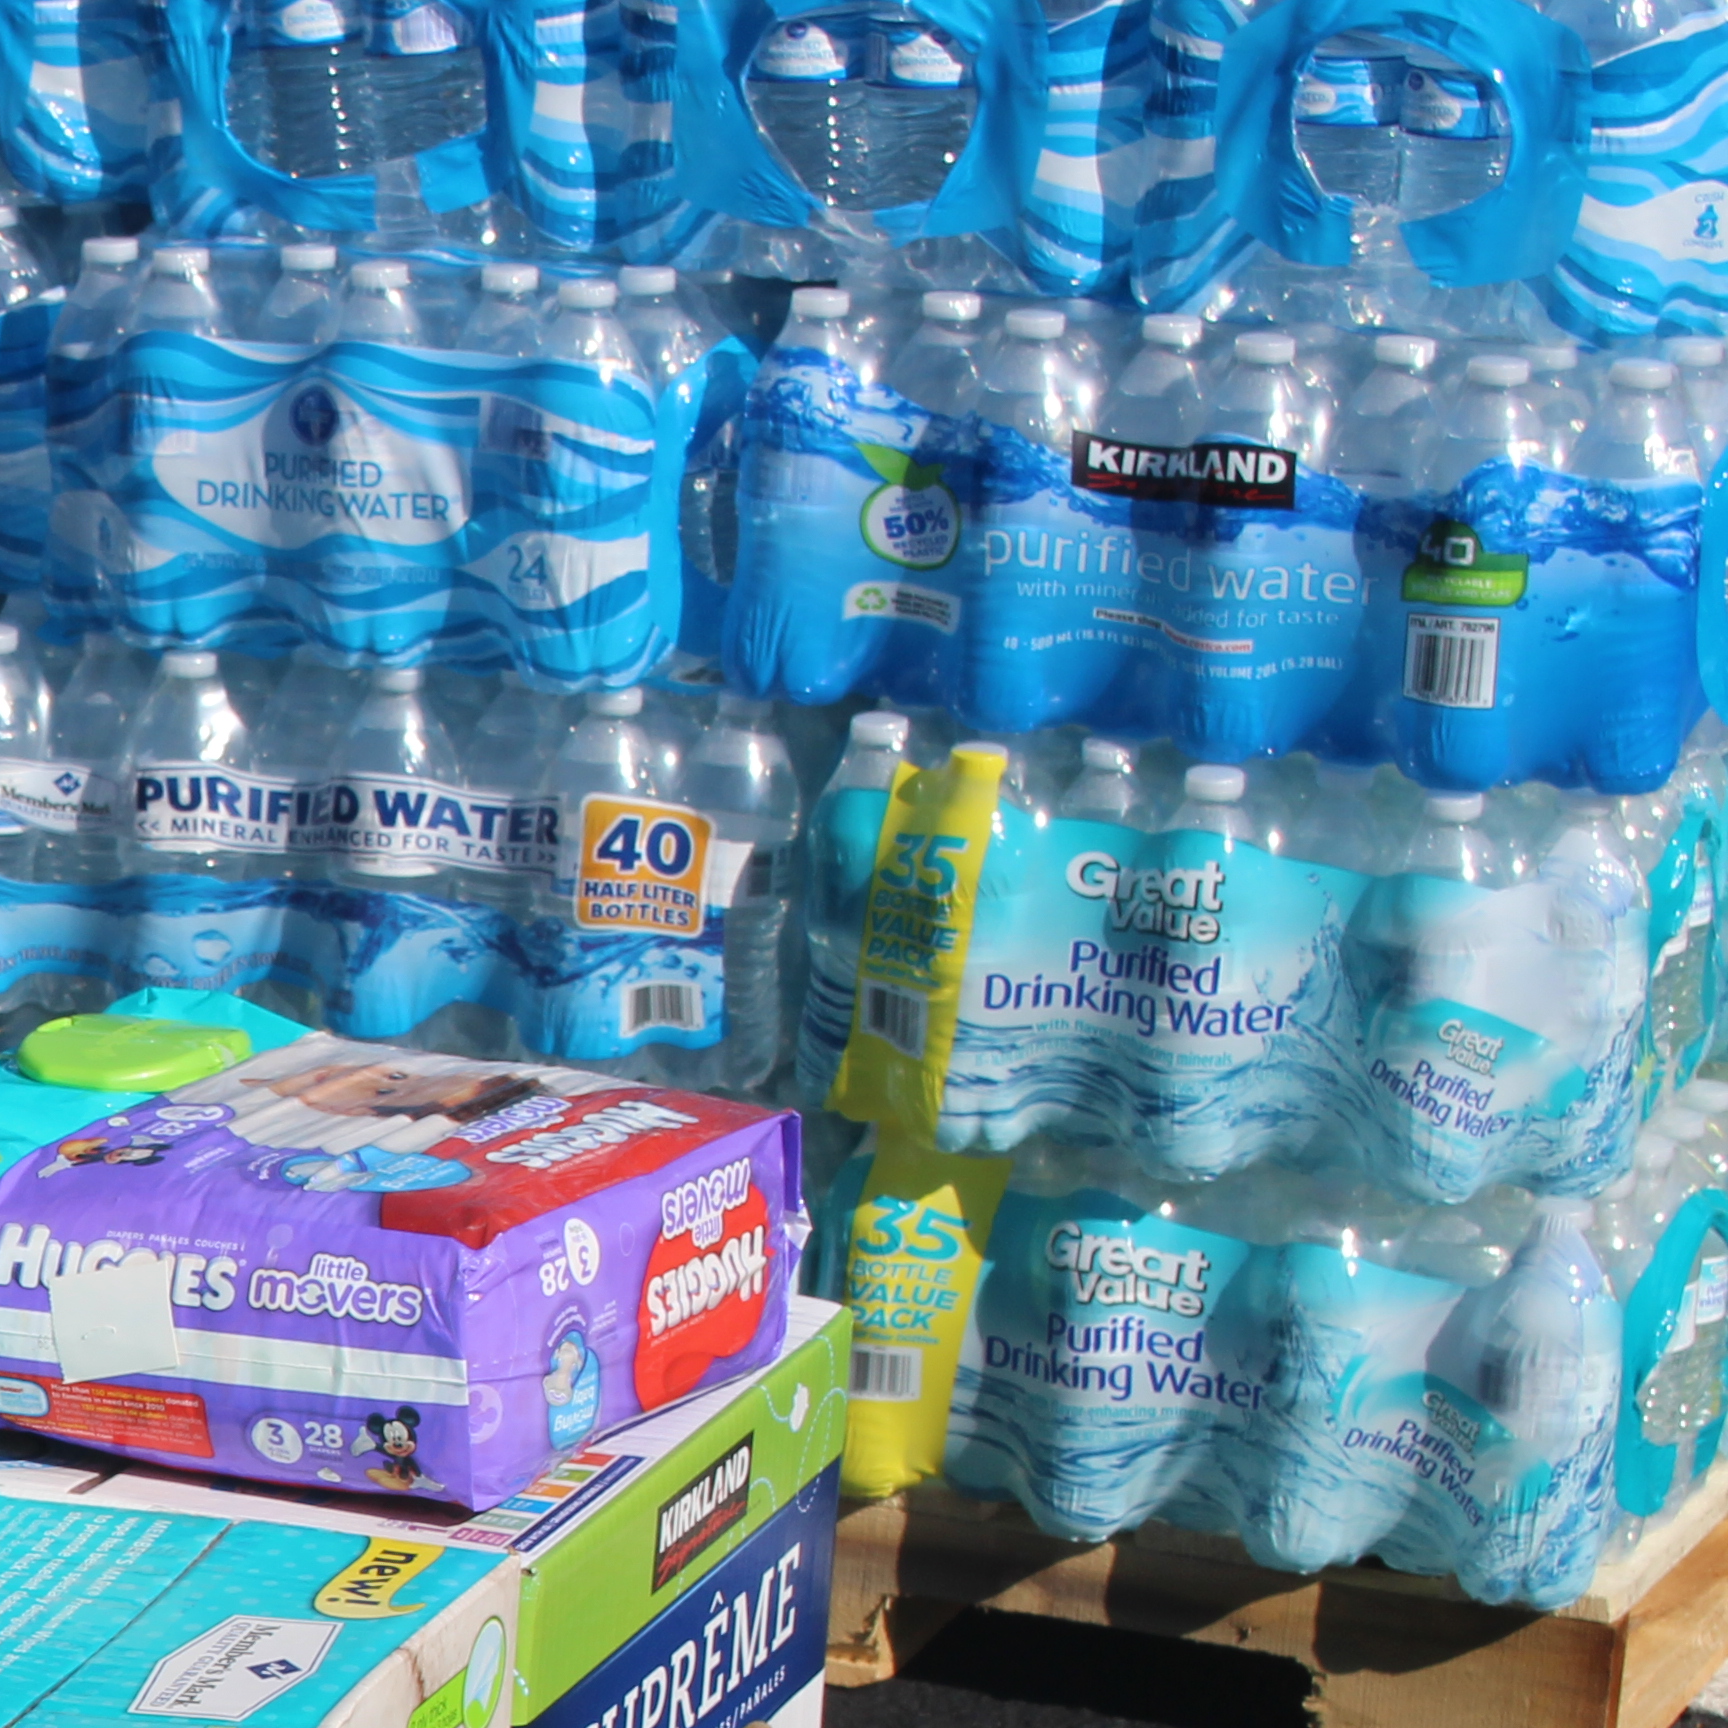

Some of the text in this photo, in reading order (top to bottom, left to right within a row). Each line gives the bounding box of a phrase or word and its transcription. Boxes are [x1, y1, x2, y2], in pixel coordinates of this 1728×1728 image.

[264, 452, 382, 487] PURIFIED
[1086, 438, 1288, 485] KIRKLAND
[197, 480, 449, 522] DRINKING WATER
[883, 508, 949, 540] 50%
[506, 544, 546, 586] 24
[984, 530, 1374, 605] purified water
[136, 776, 358, 824] PURIFIED
[374, 789, 559, 845] WATER
[170, 819, 277, 844] MINERAL
[596, 818, 692, 878] 40
[878, 833, 967, 898] 35
[1066, 851, 1226, 913] Great
[583, 881, 696, 909] HALF LITER
[591, 902, 690, 927] BOTTLES
[1109, 900, 1220, 943] Value
[1070, 941, 1221, 996] Purified
[983, 973, 1291, 1039] Drinking Water
[1369, 1058, 1511, 1140] Drinking Water
[1413, 1059, 1495, 1112] Purified
[856, 1195, 972, 1264] 35
[1046, 1220, 1209, 1291] Great
[249, 1267, 423, 1325] movers
[647, 1225, 767, 1337] HUGGIES
[849, 1281, 959, 1310] VALUE
[1074, 1271, 1204, 1318] Value
[1047, 1313, 1204, 1364] Purified
[985, 1335, 1264, 1411] Drinking Water
[1396, 1418, 1474, 1485] Purified
[658, 1444, 751, 1555] KIRKLAND
[327, 1548, 419, 1608] new!
